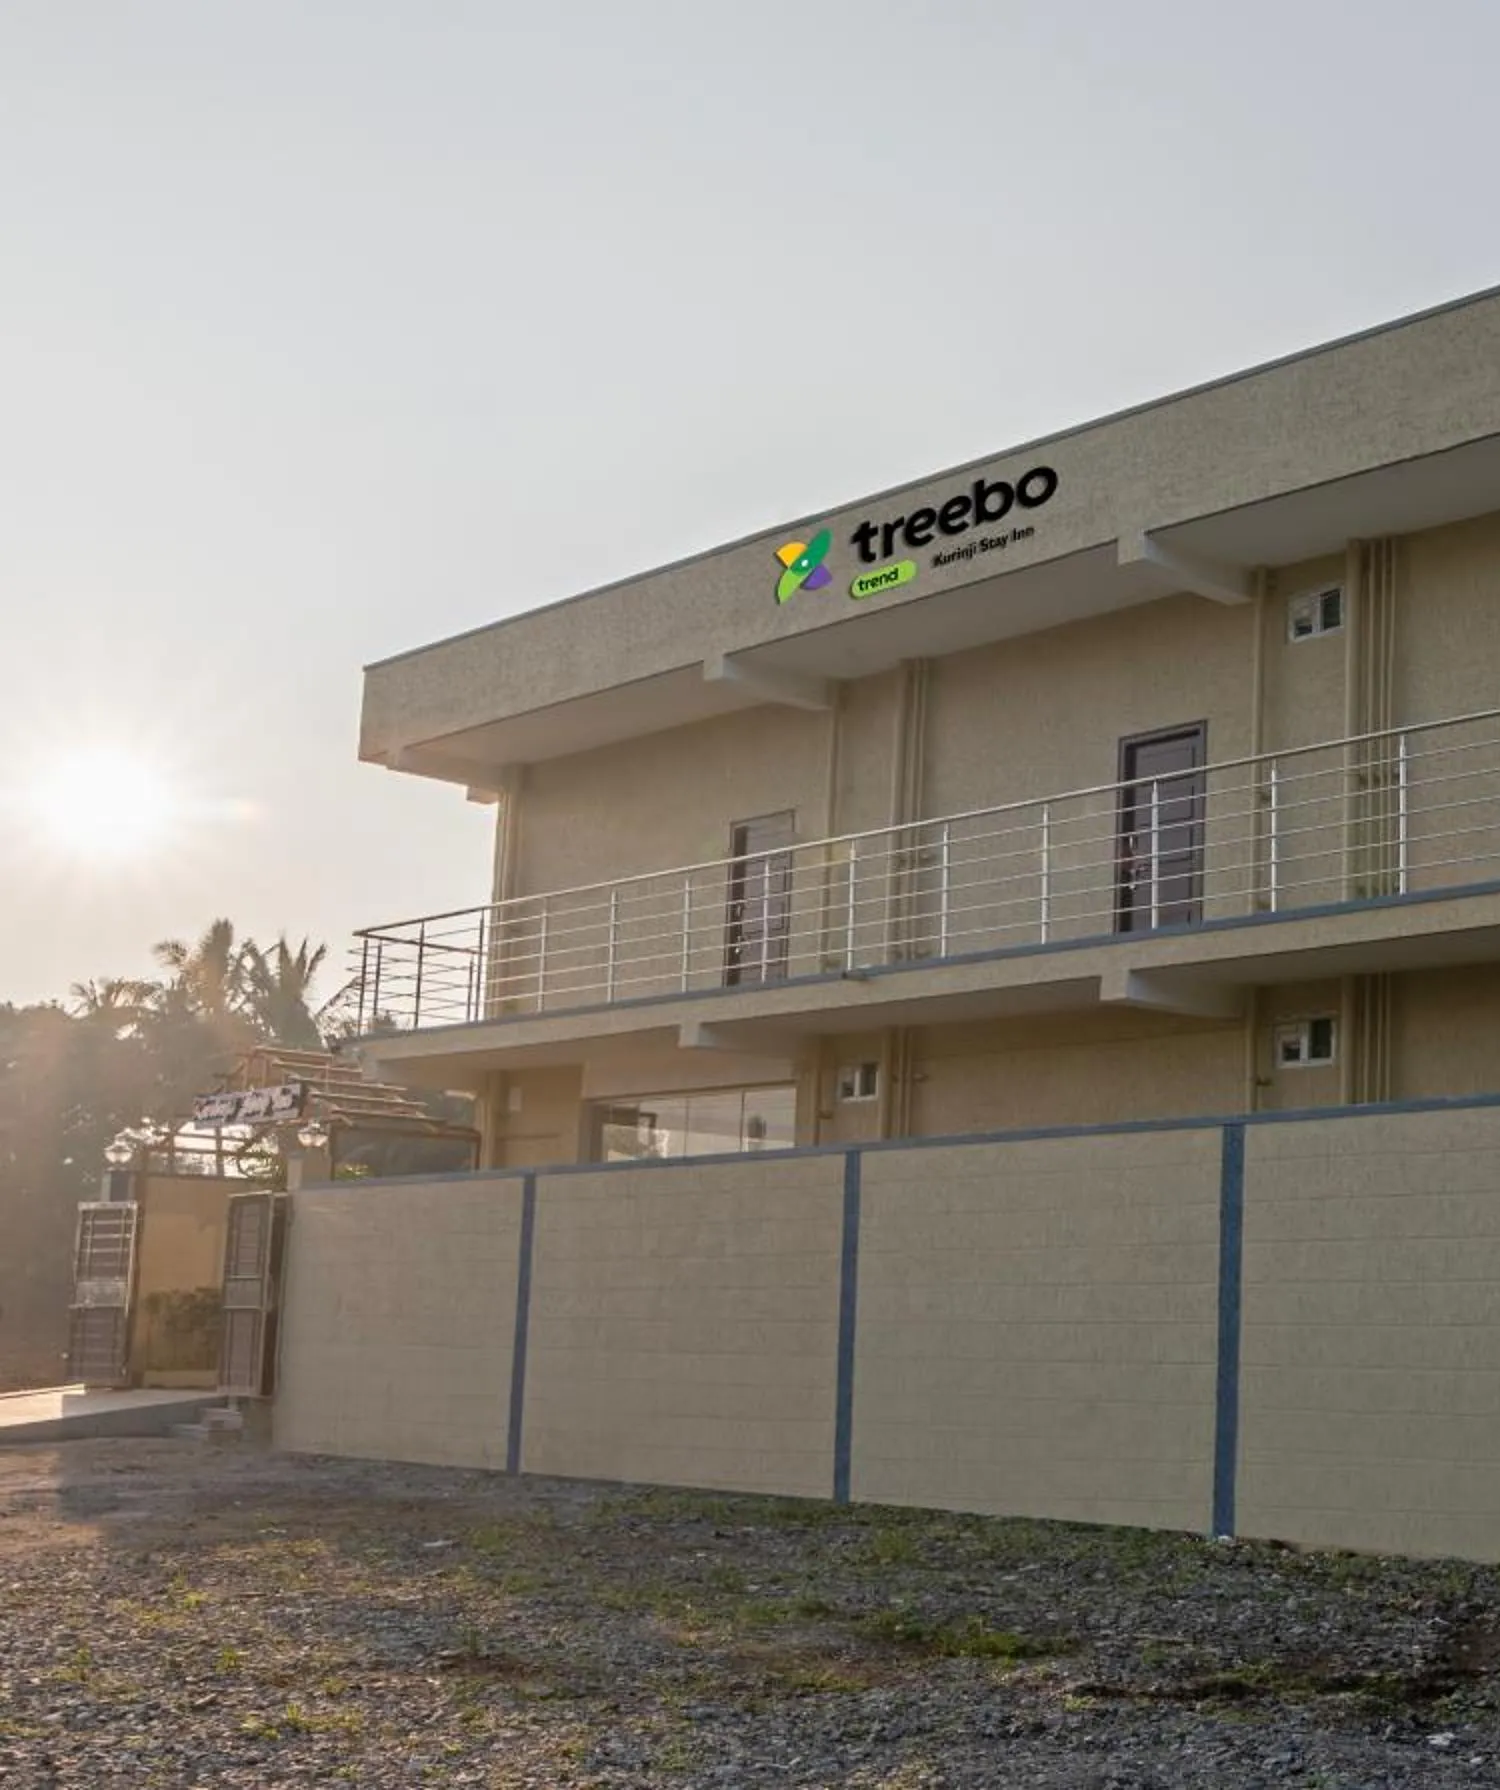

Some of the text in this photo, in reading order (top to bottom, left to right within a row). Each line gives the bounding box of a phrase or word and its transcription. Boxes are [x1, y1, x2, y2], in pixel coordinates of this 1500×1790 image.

[851, 466, 1058, 563] treebo
[931, 526, 1034, 568] Kurinji Stay Inn
[858, 567, 899, 591] trend
